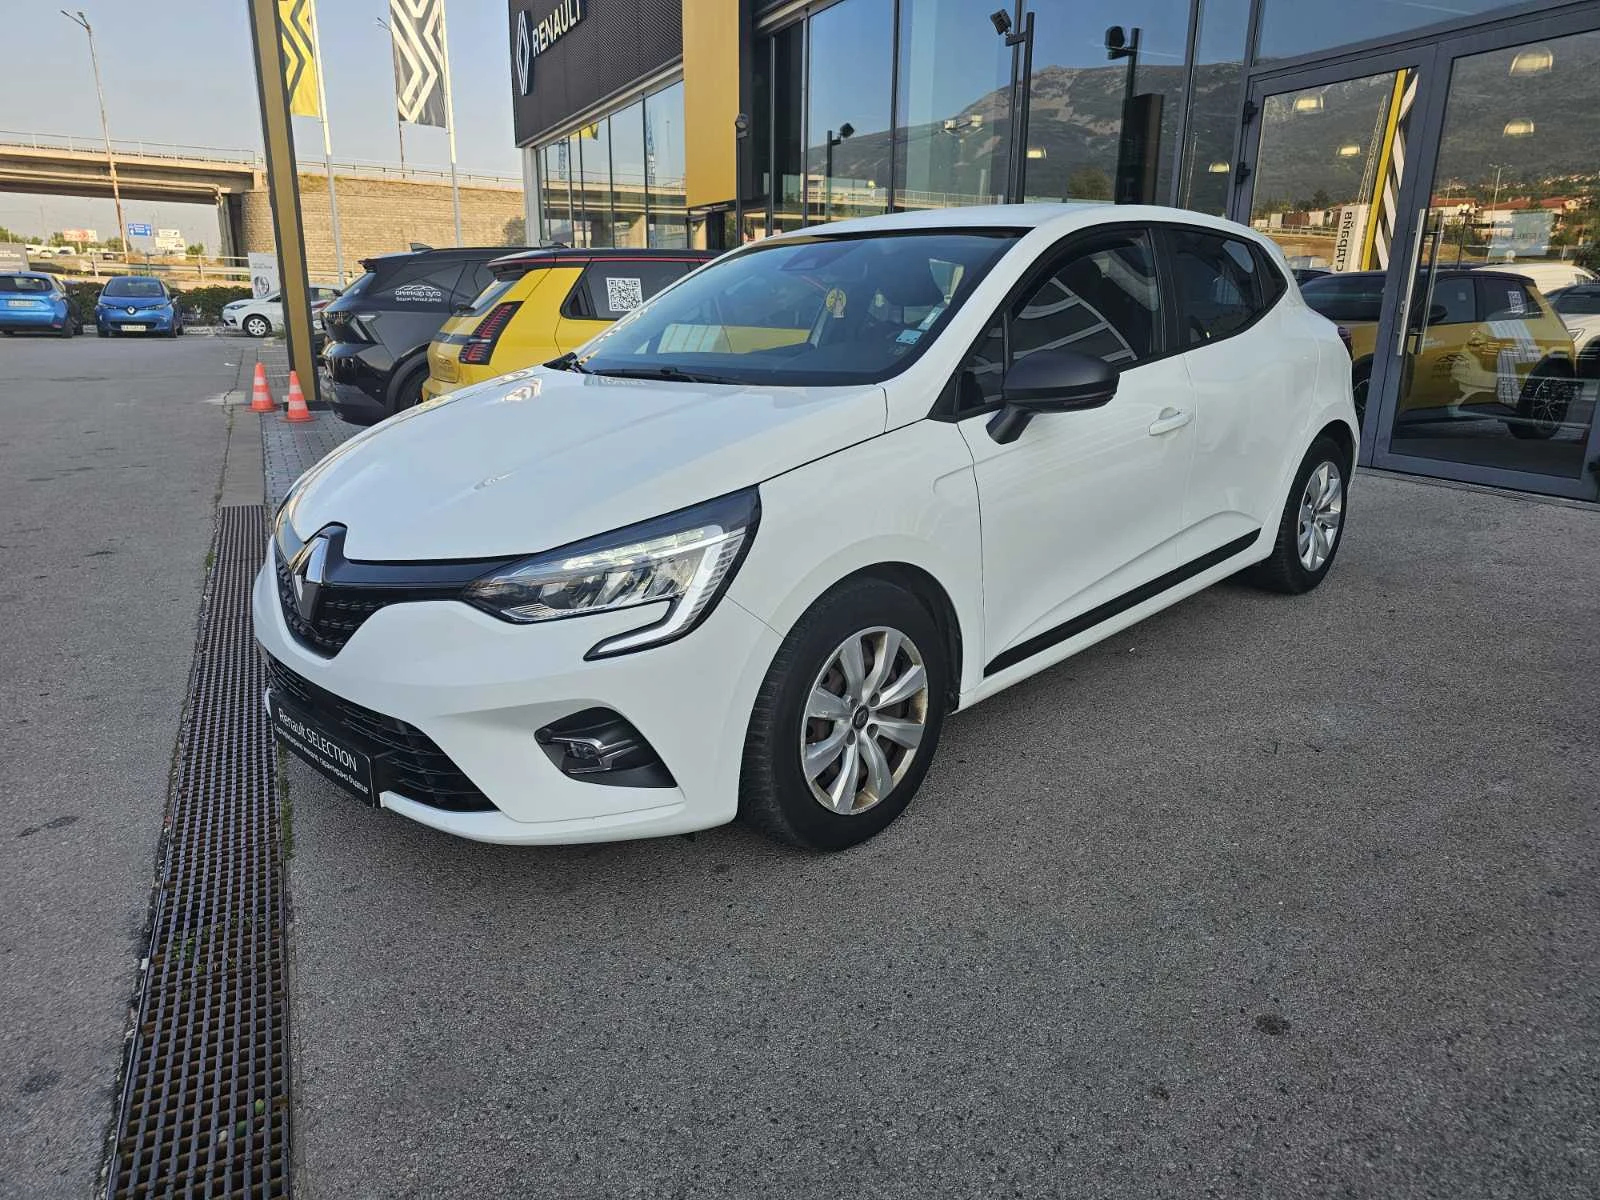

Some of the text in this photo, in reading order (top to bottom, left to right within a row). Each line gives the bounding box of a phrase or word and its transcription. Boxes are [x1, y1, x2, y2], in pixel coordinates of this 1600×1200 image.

[532, 0, 581, 57] RENAULT
[278, 707, 307, 739] Renault
[306, 727, 358, 772] SELECTION
